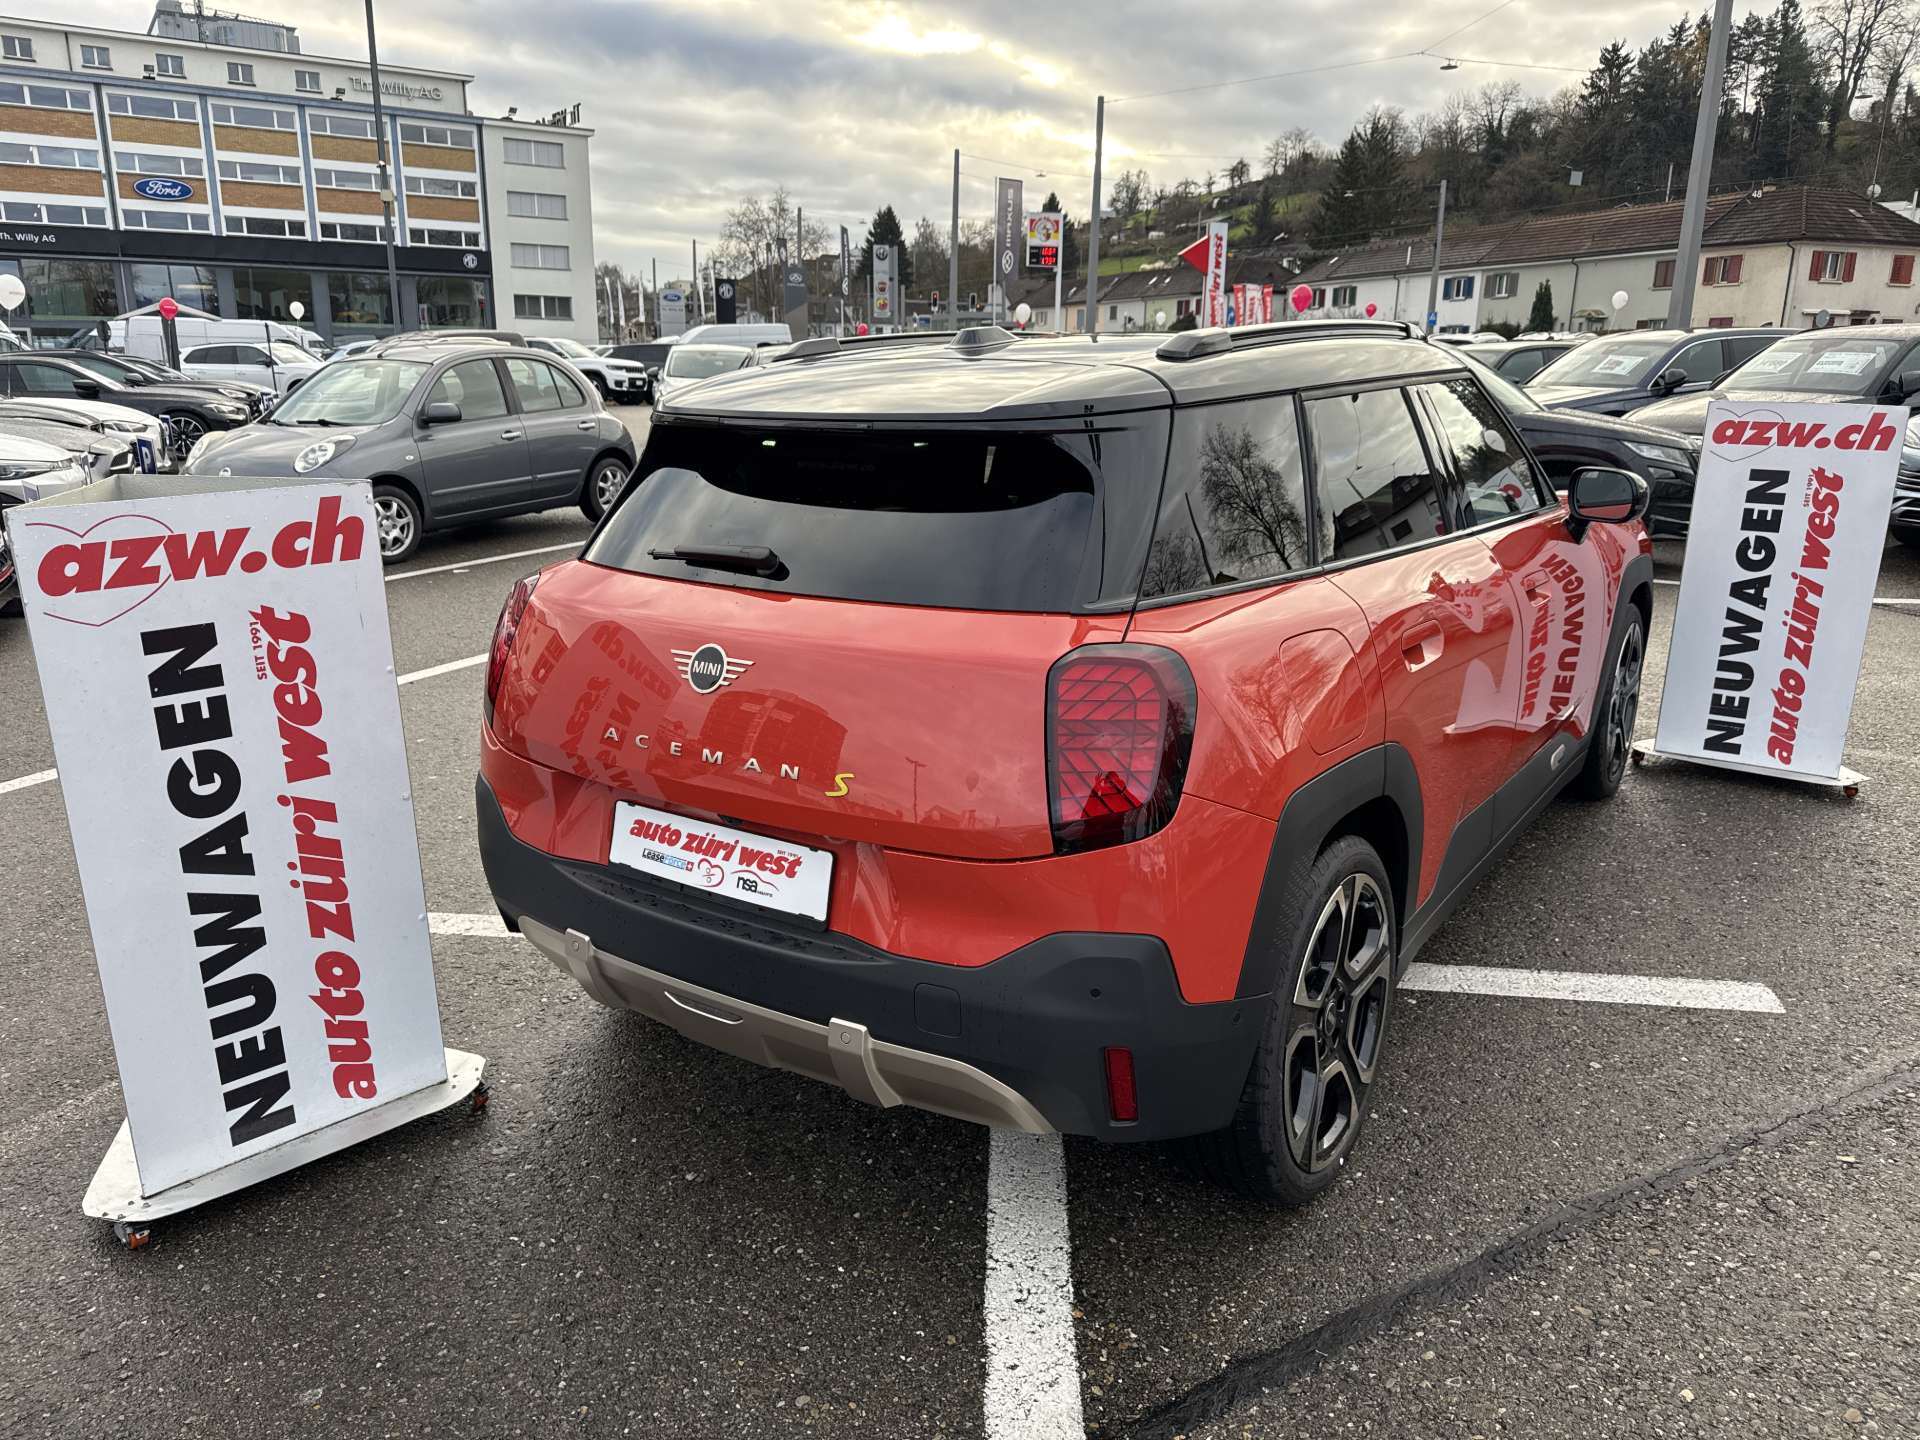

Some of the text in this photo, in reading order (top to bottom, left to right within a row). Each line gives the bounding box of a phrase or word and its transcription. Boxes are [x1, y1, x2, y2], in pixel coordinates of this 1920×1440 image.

[420, 87, 442, 100] AG
[15, 233, 39, 244] Willy
[42, 235, 56, 243] AG
[1711, 412, 1897, 452] azw.ch
[37, 495, 365, 597] azw.ch
[1703, 468, 1791, 755] NEUWAGEN
[1767, 465, 1844, 766] auto züri west
[249, 621, 268, 680] SEIT 1991
[692, 660, 722, 677] MINI
[604, 727, 799, 781] ACEMAN
[824, 773, 855, 797] S
[248, 604, 378, 1100] auto züri west
[629, 819, 803, 878] auto züri west
[140, 622, 297, 1147] NEUWAGEN
[736, 876, 758, 893] nsa
